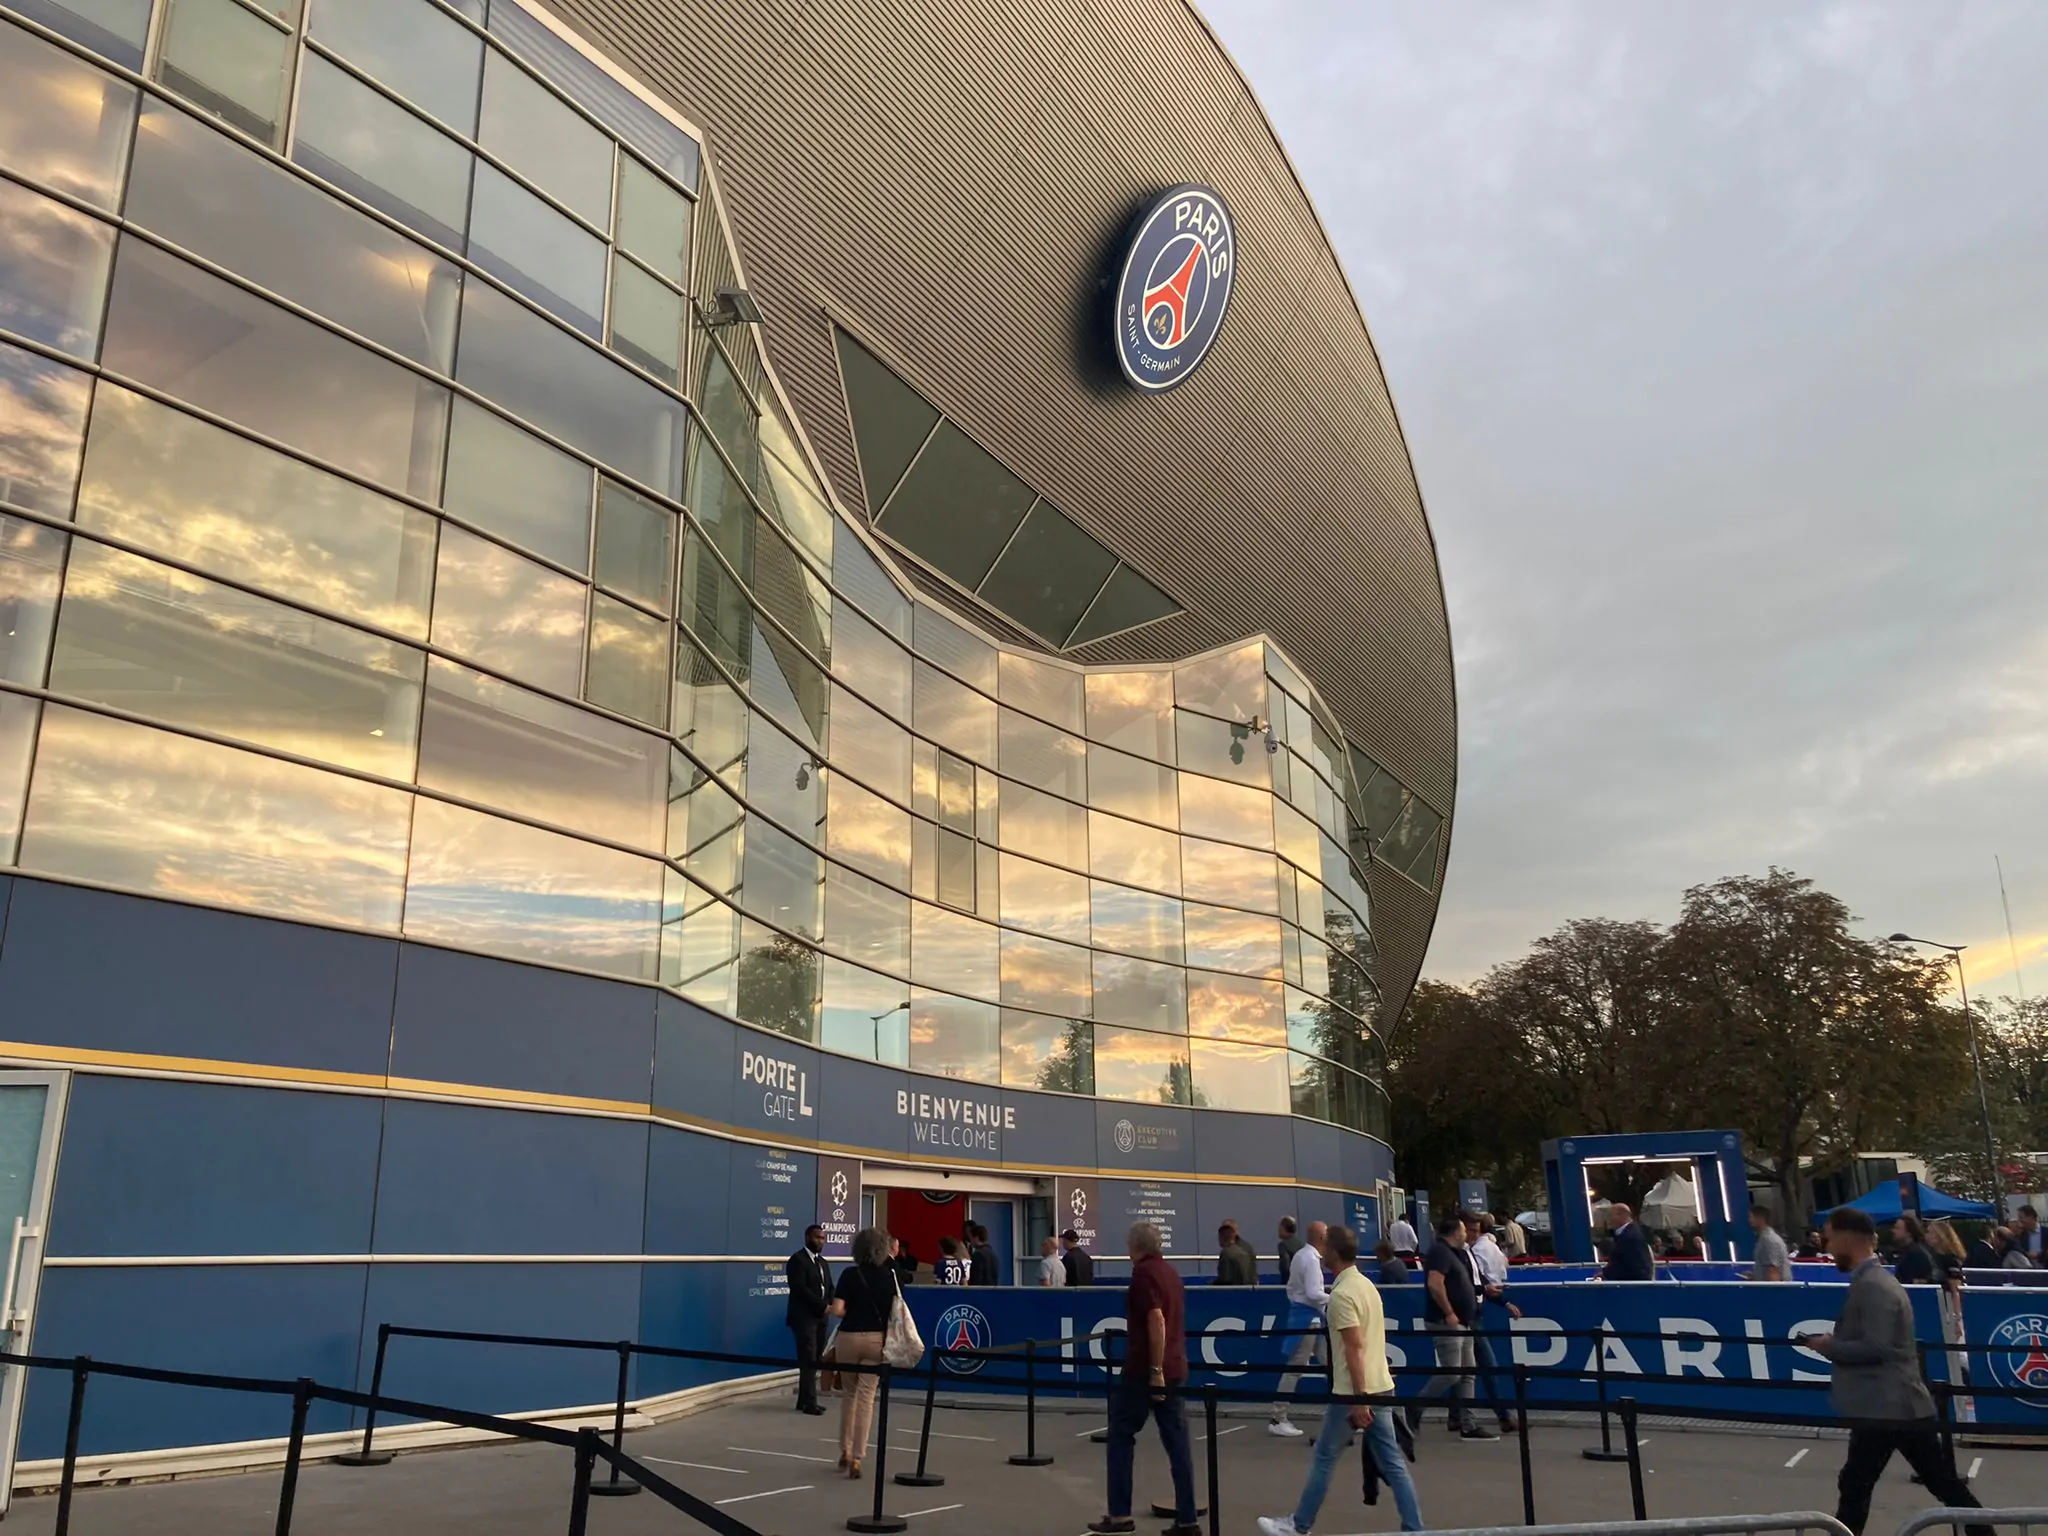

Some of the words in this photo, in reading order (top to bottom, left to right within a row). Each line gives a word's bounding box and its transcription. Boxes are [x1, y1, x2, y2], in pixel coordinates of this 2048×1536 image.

[1175, 200, 1227, 280] PARIS
[742, 1051, 797, 1092] PORTE
[799, 1072, 813, 1117] L
[763, 1091, 796, 1121] GATE
[897, 1090, 1016, 1129] BIENVENUE
[914, 1121, 997, 1150] WELCOME
[1136, 1126, 1177, 1137] EXECUTIVE
[1137, 1135, 1157, 1144] CLUB
[821, 1222, 856, 1233] CHAMPIONS
[827, 1233, 850, 1244] LEAGUE
[945, 1266, 961, 1284] 30
[944, 1308, 981, 1325] PARIS
[2001, 1318, 2048, 1340] PAR
[1509, 1317, 1835, 1382] PARIS
